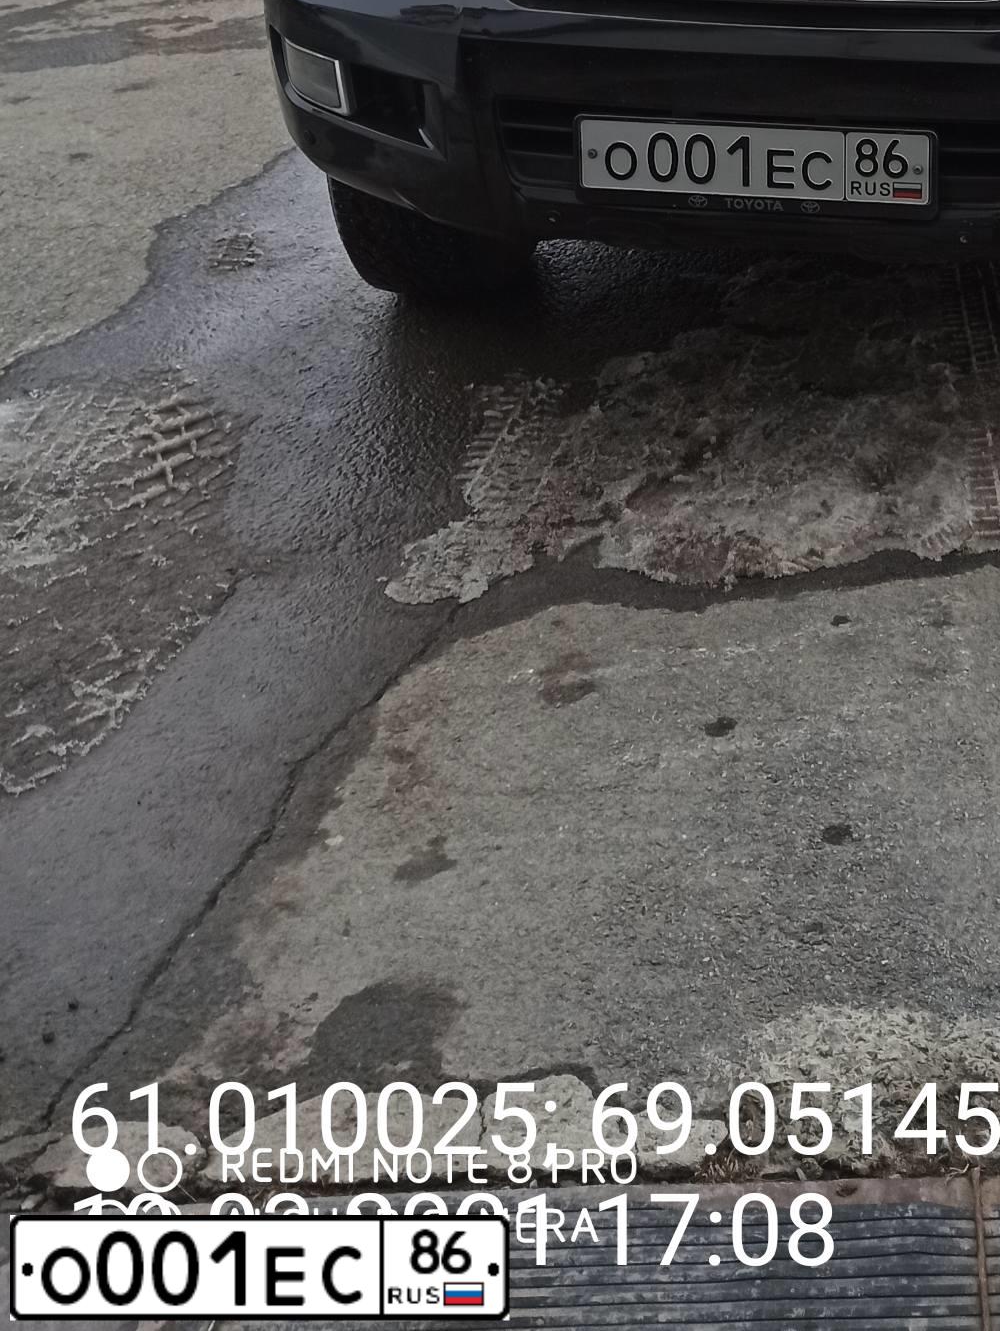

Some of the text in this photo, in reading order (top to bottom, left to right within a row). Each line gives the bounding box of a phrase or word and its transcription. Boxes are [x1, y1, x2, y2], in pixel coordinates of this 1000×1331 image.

[854, 138, 909, 179] 86
[849, 179, 892, 197] RUS
[724, 196, 785, 213] TOYOTA
